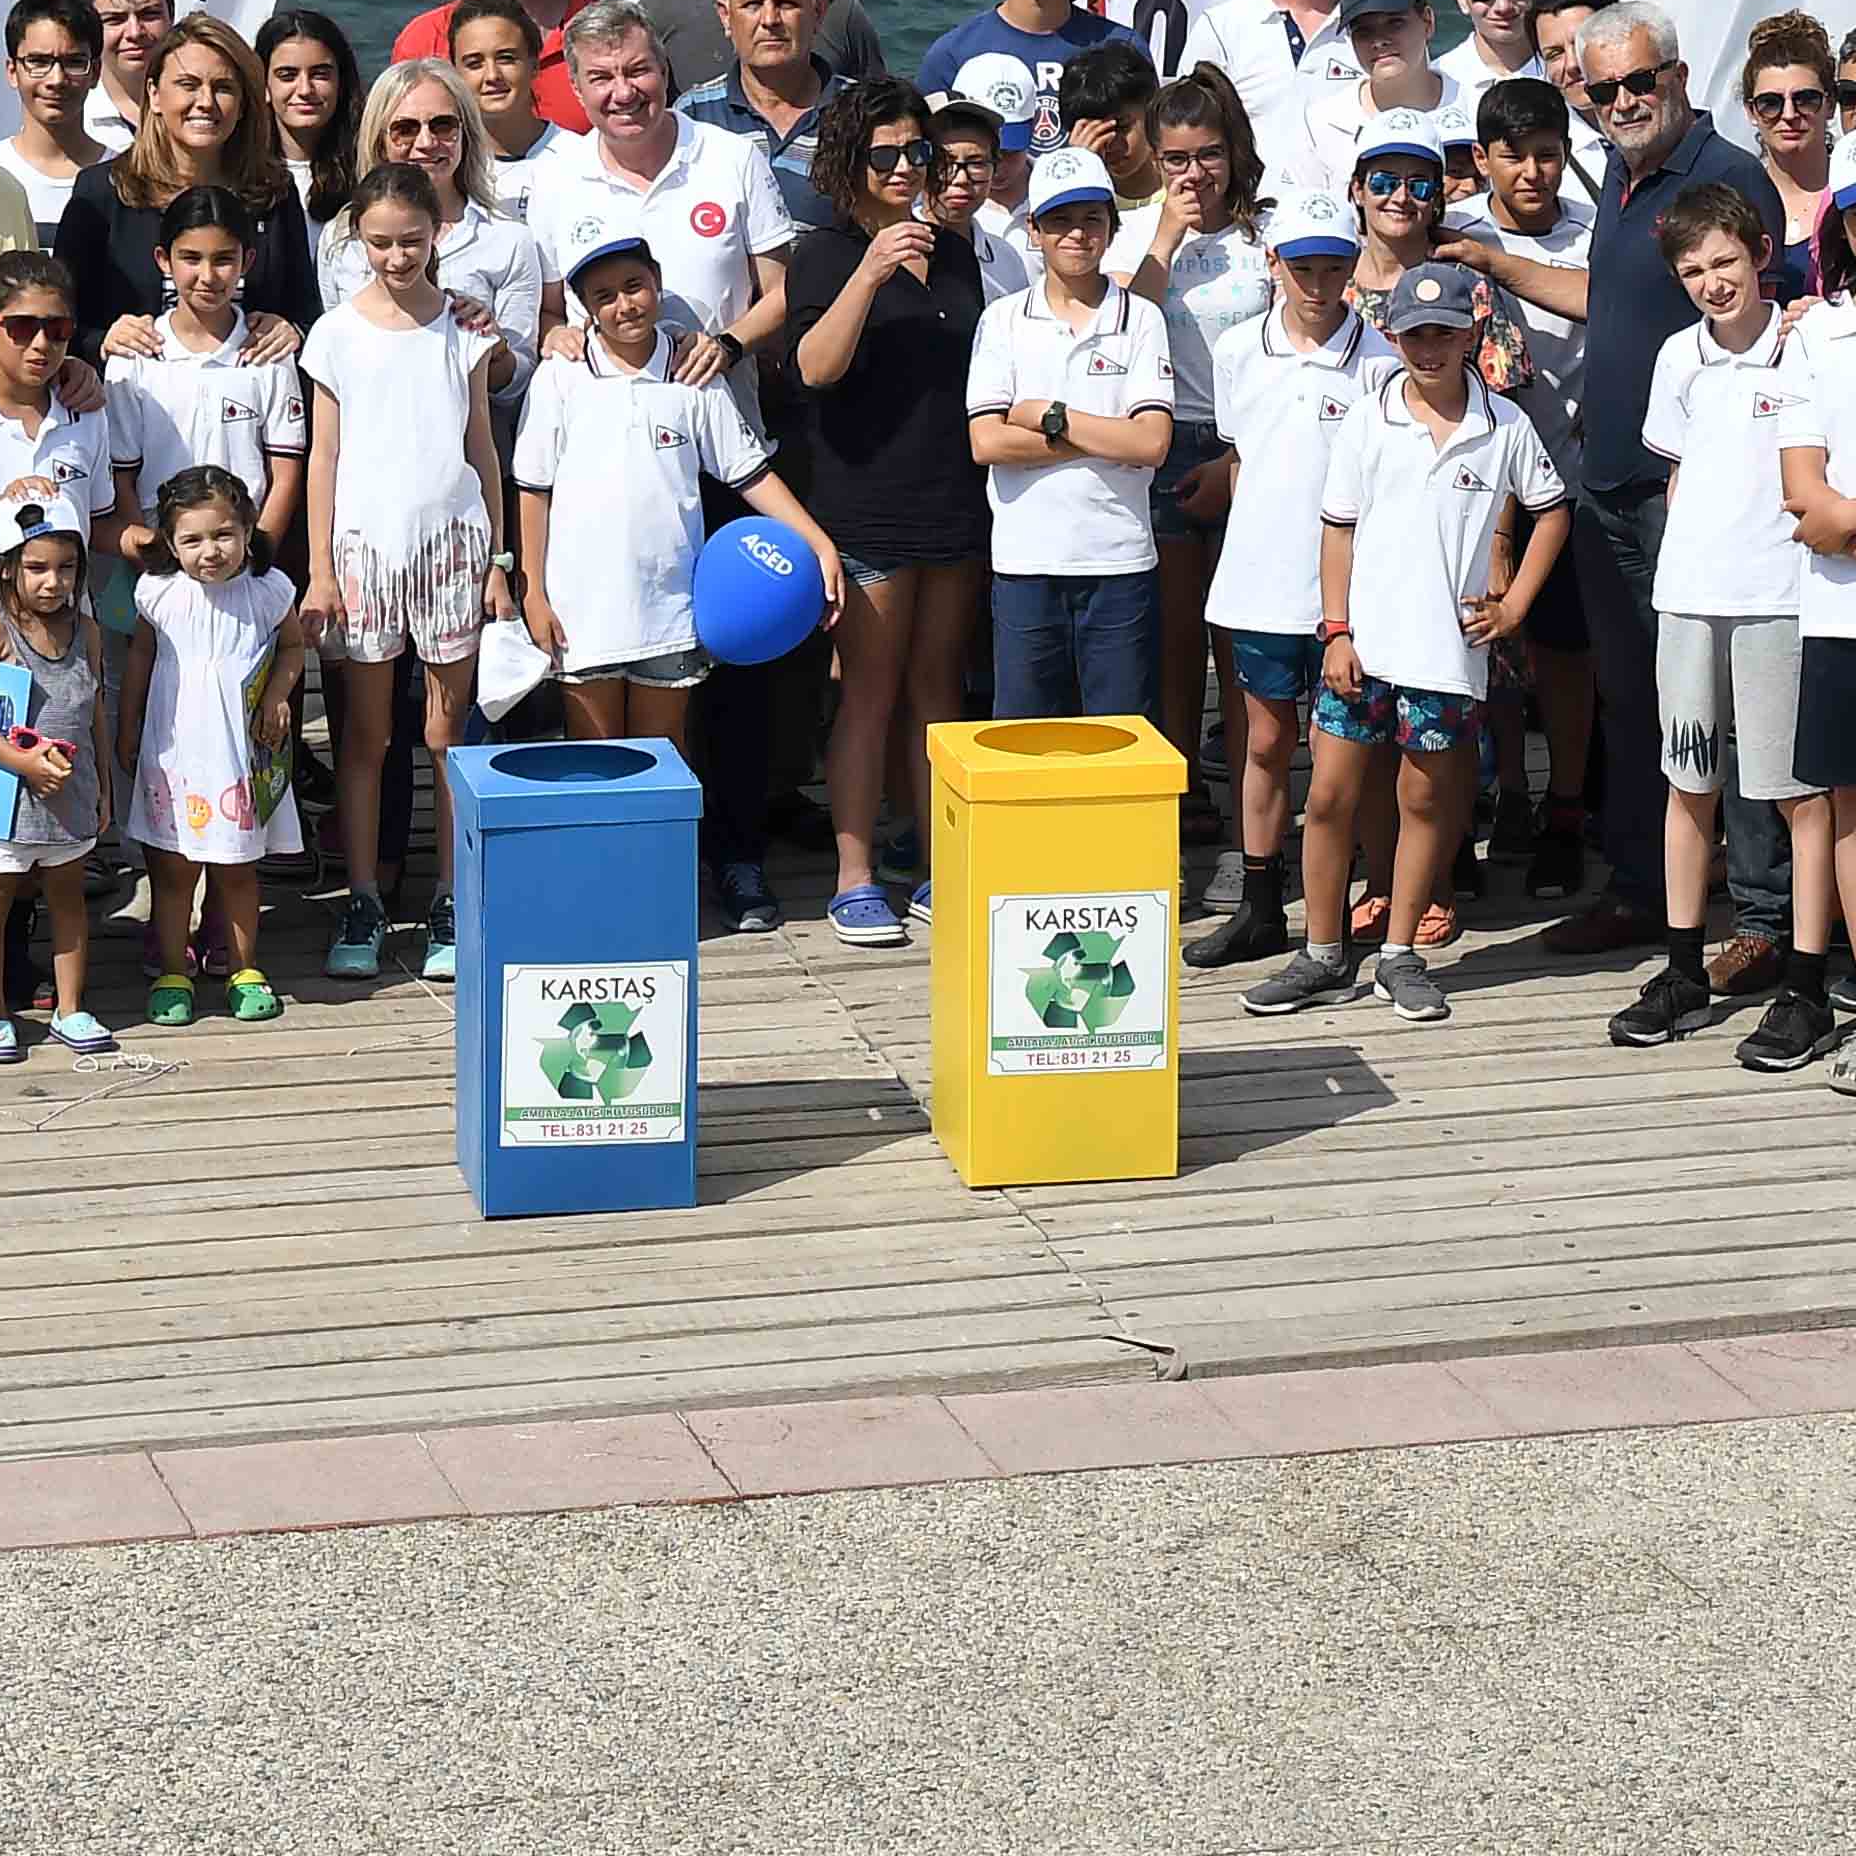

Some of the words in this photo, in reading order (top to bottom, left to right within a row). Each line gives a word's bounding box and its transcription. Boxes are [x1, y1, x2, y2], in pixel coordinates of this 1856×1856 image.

[1025, 905, 1139, 934] KARSTAŞ
[541, 976, 657, 1004] KARSTAŞ
[1026, 1051, 1086, 1066] TEL:831
[1091, 1050, 1109, 1064] 21
[1113, 1049, 1132, 1063] 25
[541, 1123, 602, 1138] TEL:831
[608, 1122, 625, 1136] 21
[630, 1121, 649, 1136] 25
